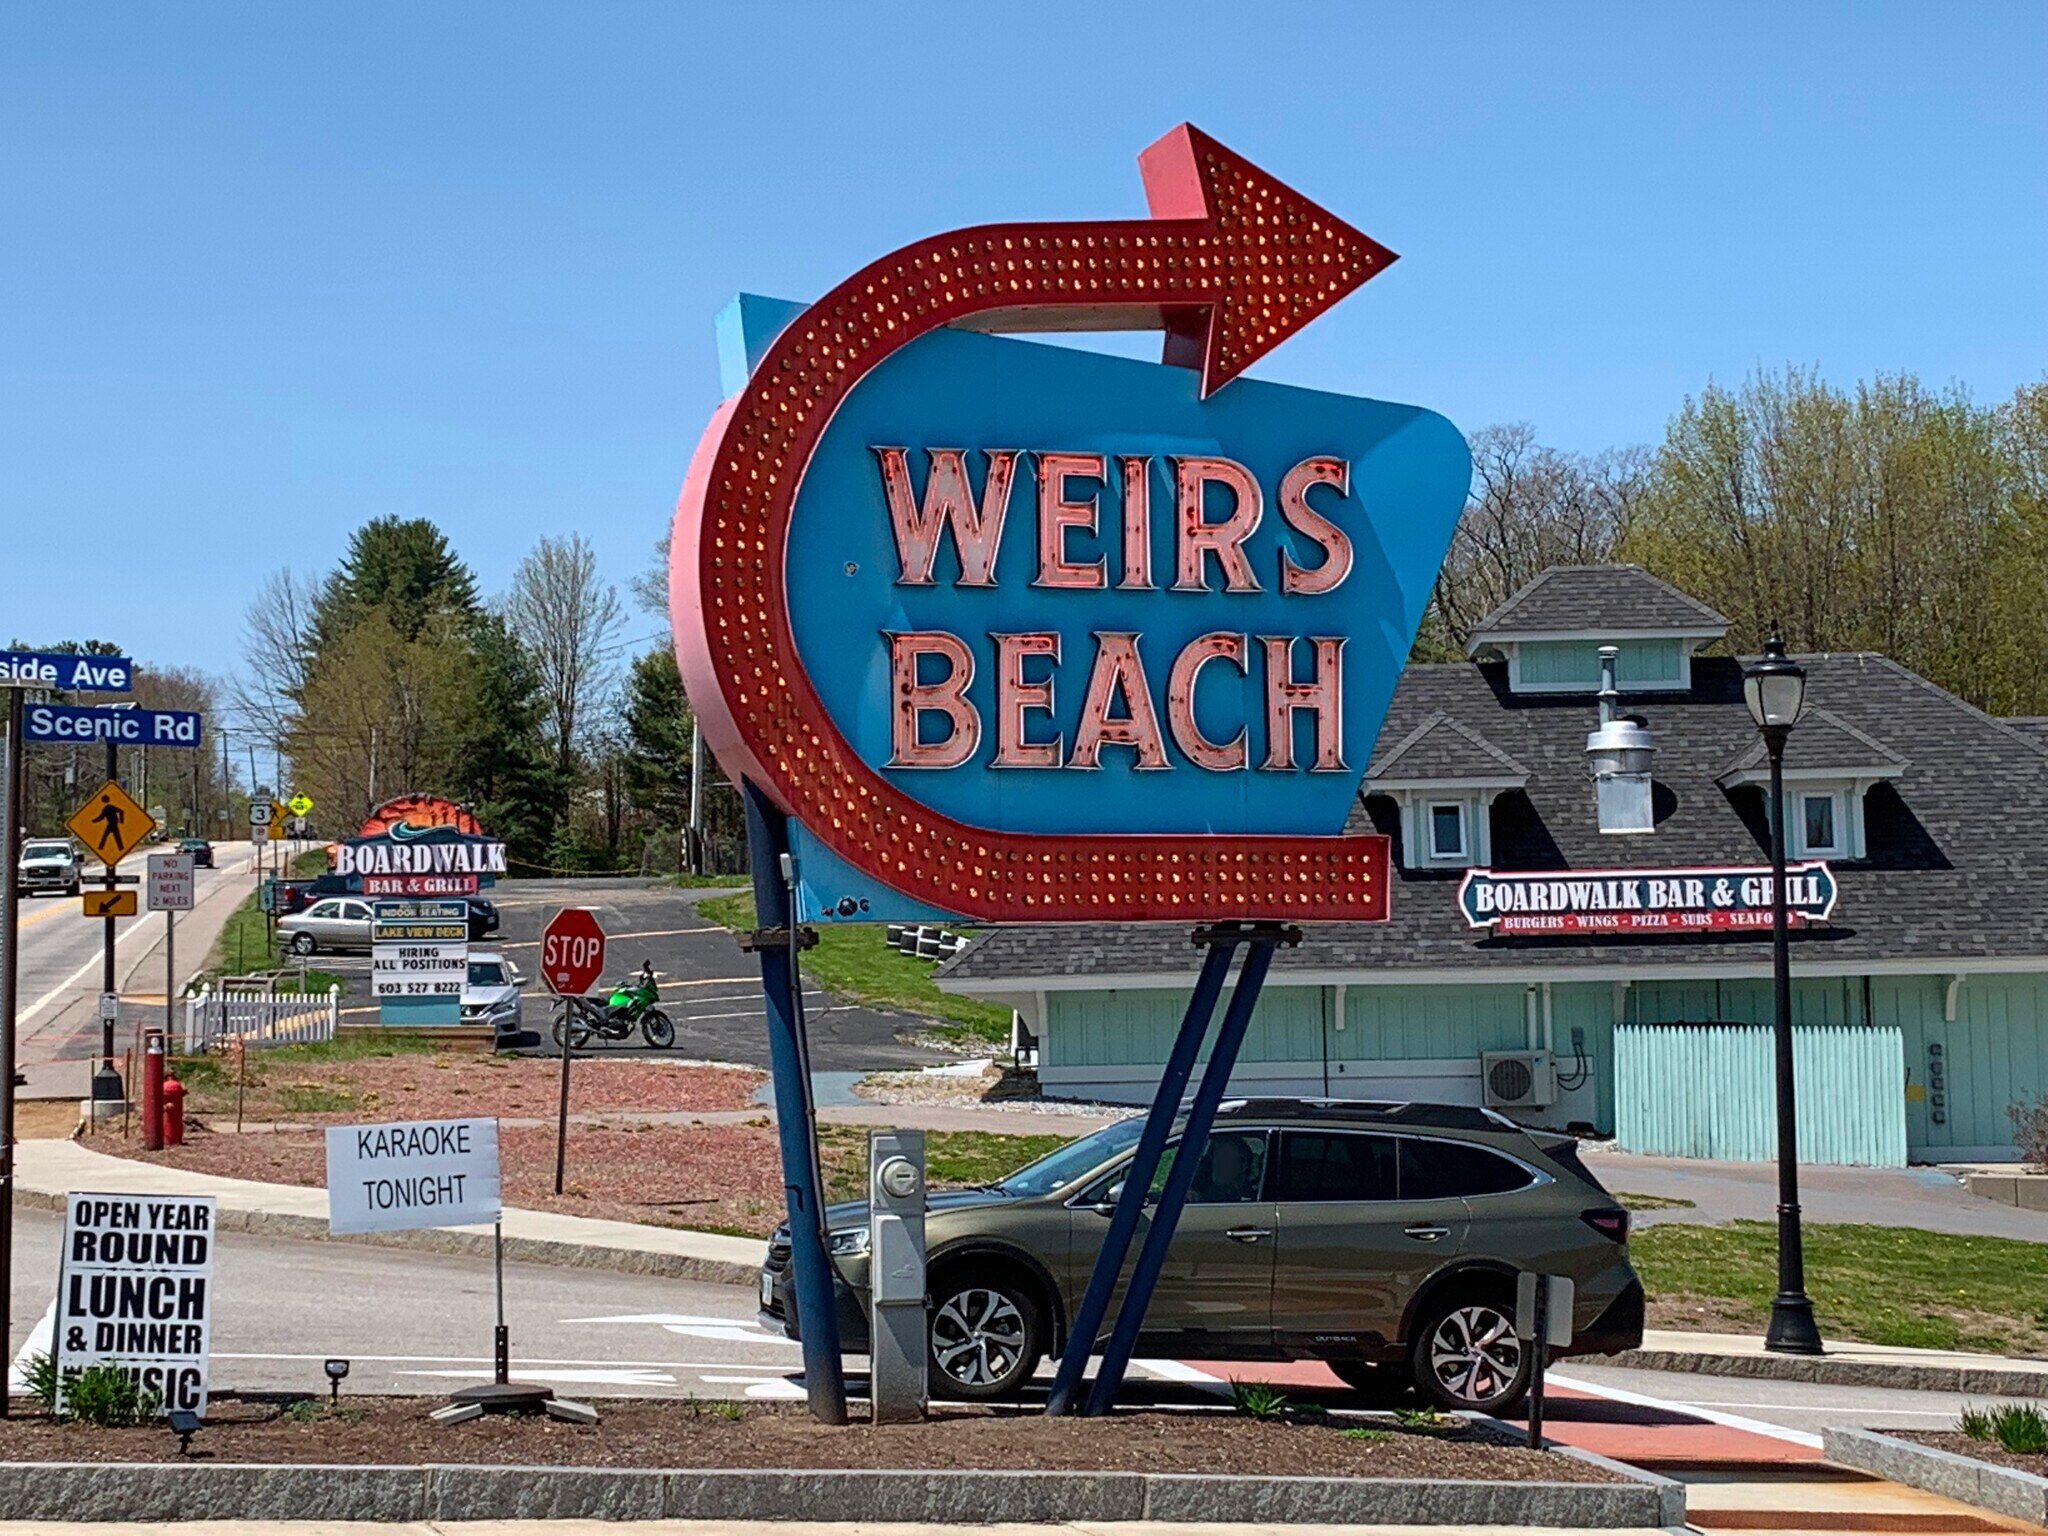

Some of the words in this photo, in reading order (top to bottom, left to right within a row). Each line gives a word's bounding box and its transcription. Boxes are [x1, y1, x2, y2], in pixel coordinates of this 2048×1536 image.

[869, 445, 1354, 595] WEIRS
[71, 660, 126, 687] Ave
[879, 630, 1350, 772] BEACH
[31, 708, 139, 738] Scenic
[154, 714, 195, 740] Rd
[256, 809, 265, 820] 3
[163, 859, 178, 868] NO
[335, 843, 507, 875] BOARDWALK
[152, 871, 189, 880] PARKING
[160, 883, 180, 893] NEXT
[369, 880, 403, 893] BAR
[407, 879, 420, 892] &
[424, 878, 473, 892] GRILL
[153, 896, 159, 906] 2
[162, 895, 188, 906] MILES
[1475, 881, 1642, 912] BOARDWALK
[1648, 879, 1705, 908] BAR
[1711, 878, 1734, 906] &
[419, 907, 460, 917] SEATING
[1504, 916, 1564, 930] BURGERS
[1576, 914, 1619, 928] WINGS
[1631, 913, 1668, 927] PIZZA
[1680, 913, 1713, 926] SUBS
[375, 927, 404, 938] LAKE
[406, 926, 435, 938] VIEW
[436, 926, 465, 938] DECK
[373, 959, 397, 970] ALL
[402, 958, 466, 970] POSITIONS
[399, 947, 440, 958] HIRING
[545, 934, 600, 969] STOP
[378, 982, 402, 994] 603
[407, 982, 429, 994] 527
[434, 982, 461, 994] 8222
[358, 1125, 471, 1159] KARAOKE
[362, 1174, 467, 1210] TONIGHT
[75, 1200, 141, 1229] OPEN
[147, 1203, 210, 1231] YEAR
[71, 1230, 208, 1265] ROUND
[69, 1274, 206, 1320] LUNCH
[66, 1325, 88, 1352] &
[95, 1321, 203, 1354] DINNER
[87, 1366, 201, 1410] USIC
